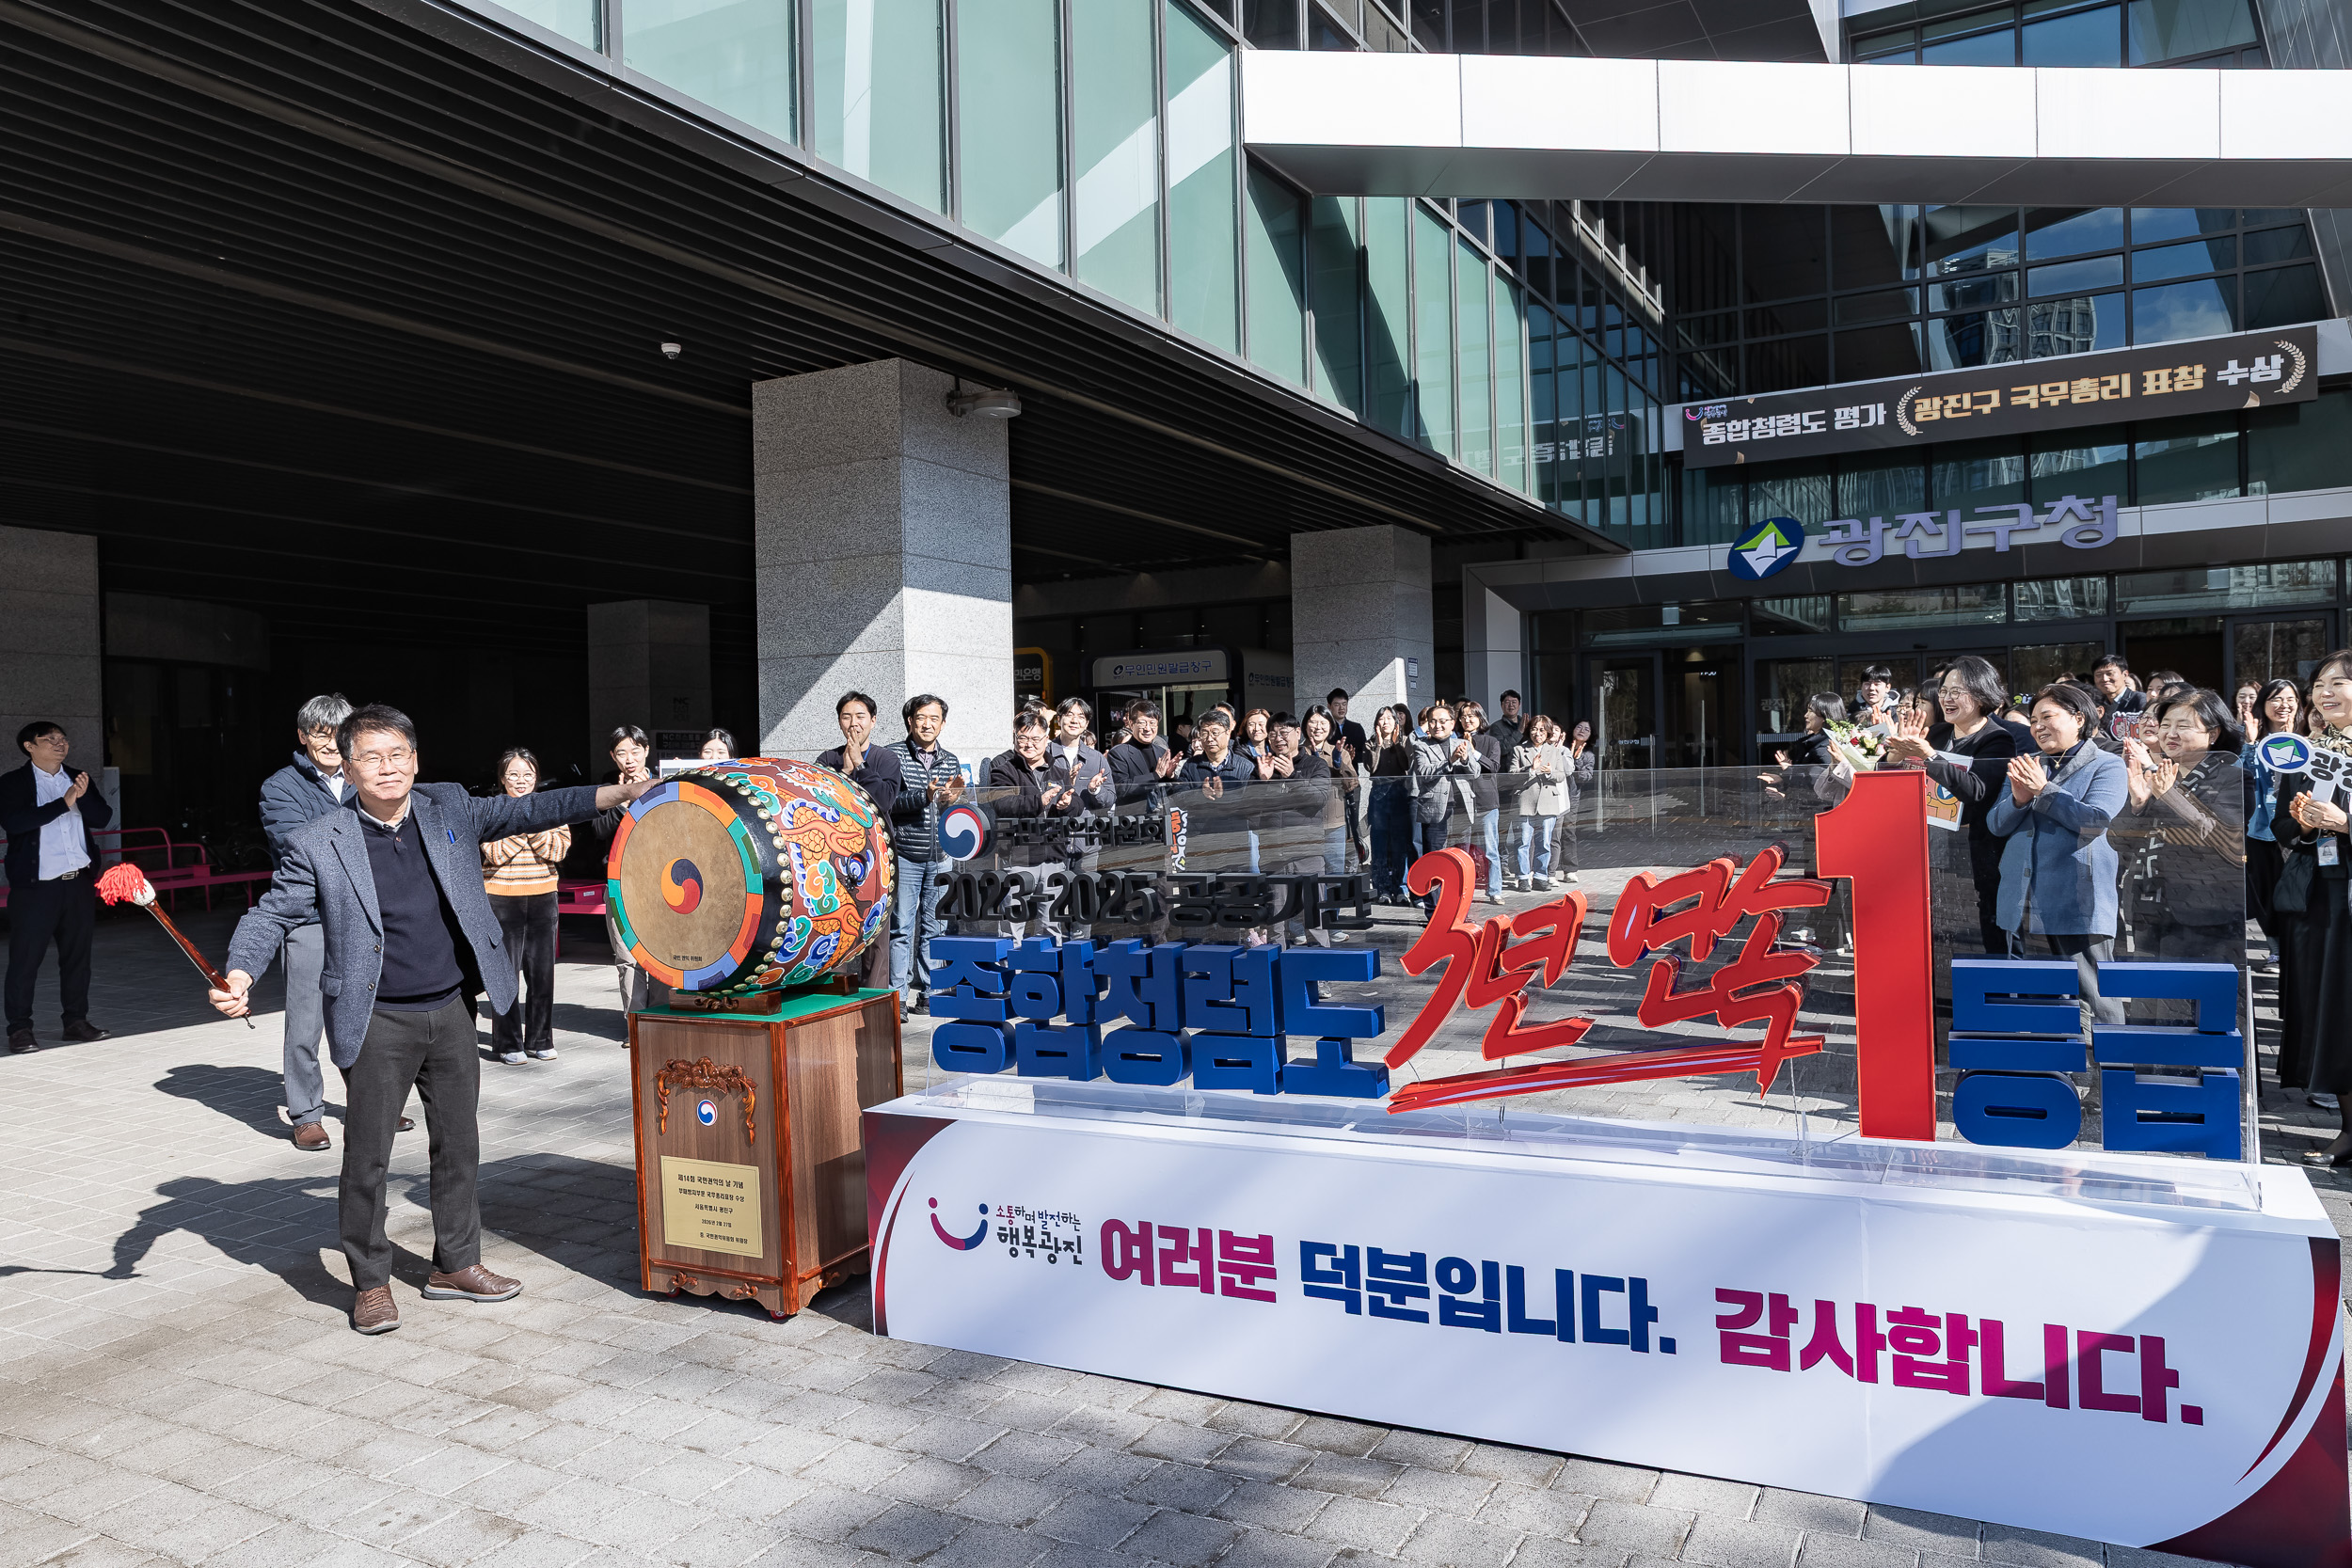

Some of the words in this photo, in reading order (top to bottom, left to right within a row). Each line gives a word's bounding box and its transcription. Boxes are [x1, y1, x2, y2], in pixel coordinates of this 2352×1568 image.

[1702, 409, 1827, 446] 종합청렴도
[1834, 403, 1887, 431] 평가
[1914, 388, 2001, 422] 광진구
[2010, 373, 2132, 409] 국무총리
[2142, 363, 2207, 396] 표창
[2217, 354, 2284, 386] 수상
[1819, 495, 2117, 566] 광진구청
[1125, 660, 1212, 676] 무인민원발급창구
[993, 816, 1171, 847] 국민권익위원회
[933, 871, 1161, 927] 2023-2025
[1166, 872, 1378, 929] 공공기관
[930, 936, 1391, 1099] 종합청렴도
[1383, 847, 1597, 1070] 3년
[1606, 845, 1832, 1100] 연속
[677, 1173, 695, 1182] 제14회
[697, 1176, 723, 1187] 국민권익의
[733, 1180, 744, 1189] 기념
[996, 1205, 1036, 1226] 소통하며
[1038, 1209, 1081, 1232] 발전하는
[996, 1225, 1083, 1265] 행복광진
[1100, 1218, 1278, 1304] 여러분
[1299, 1241, 1677, 1354] 덕분입니다.
[1714, 1287, 2204, 1426] 감사합니다.
